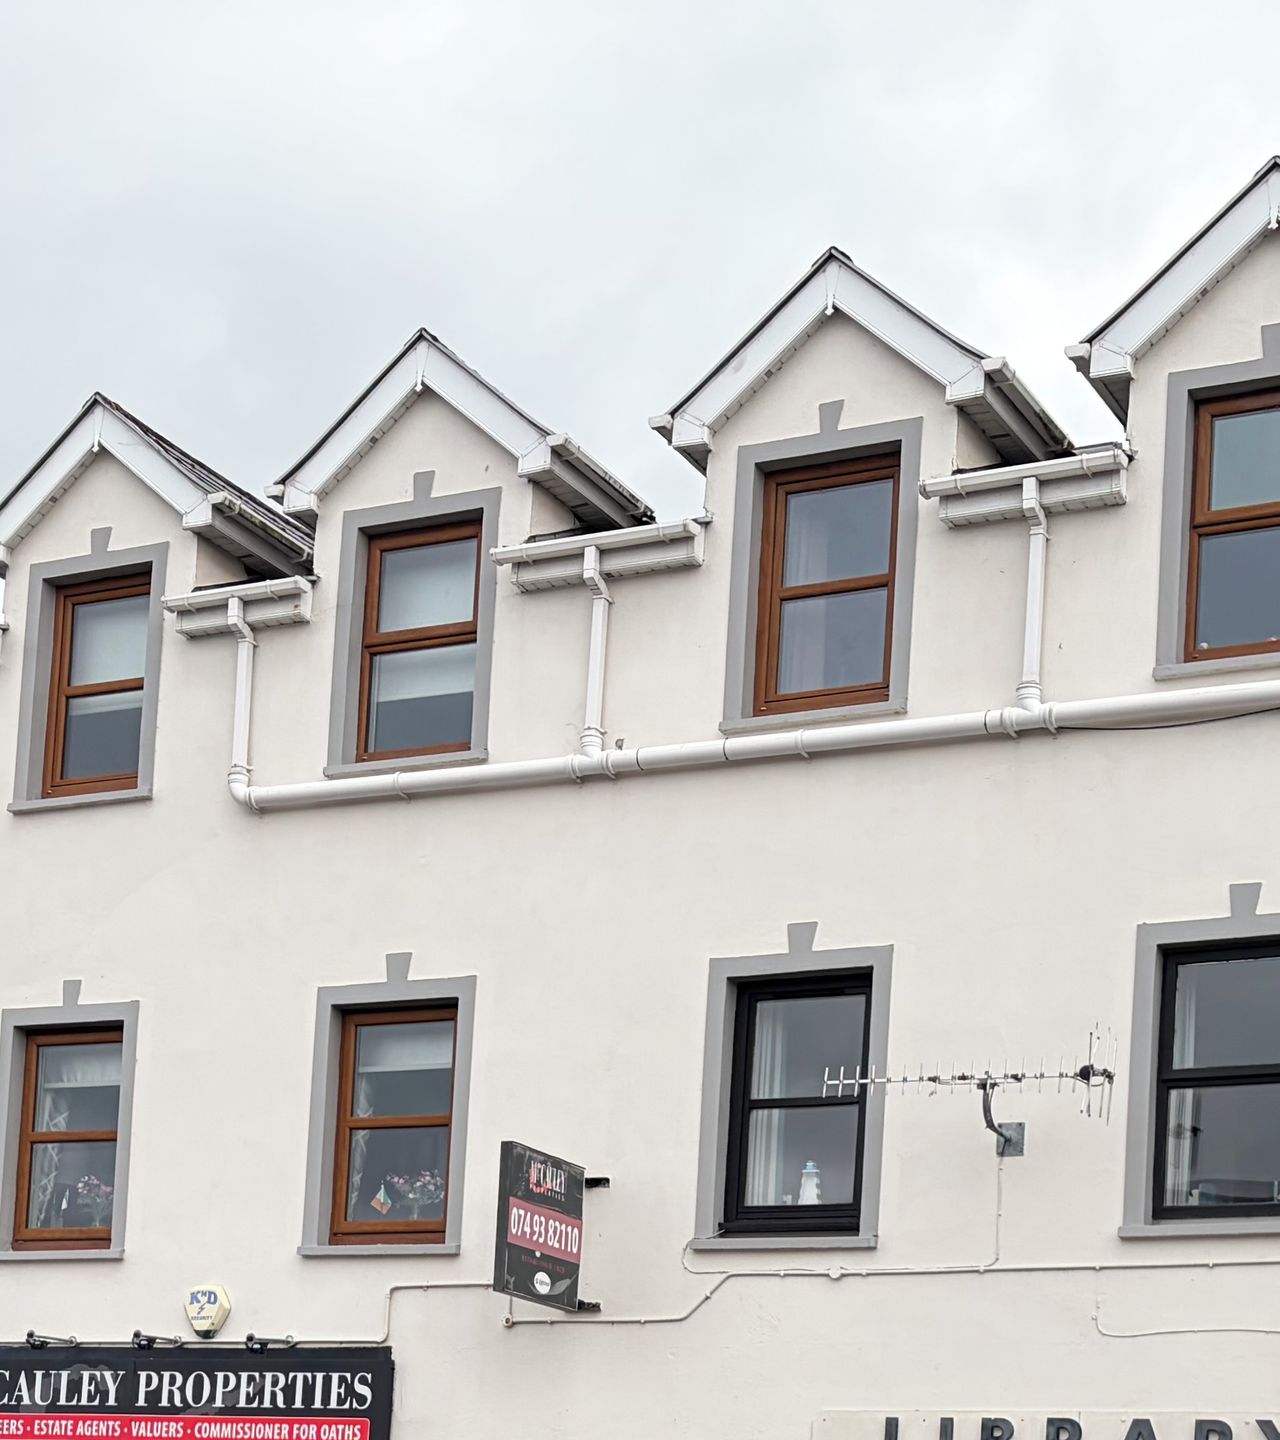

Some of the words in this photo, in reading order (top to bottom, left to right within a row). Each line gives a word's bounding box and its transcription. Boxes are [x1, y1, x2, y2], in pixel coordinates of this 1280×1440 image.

[511, 1207, 531, 1239] 074
[533, 1214, 545, 1243] 93
[547, 1219, 579, 1254] 82110
[135, 1371, 373, 1410] PROPERTIES
[33, 1420, 73, 1437] ESTATE
[76, 1420, 121, 1438] AGENTS
[131, 1421, 184, 1439] VALUERS
[194, 1422, 290, 1440] COMMISSIONER
[292, 1423, 317, 1440] FOR
